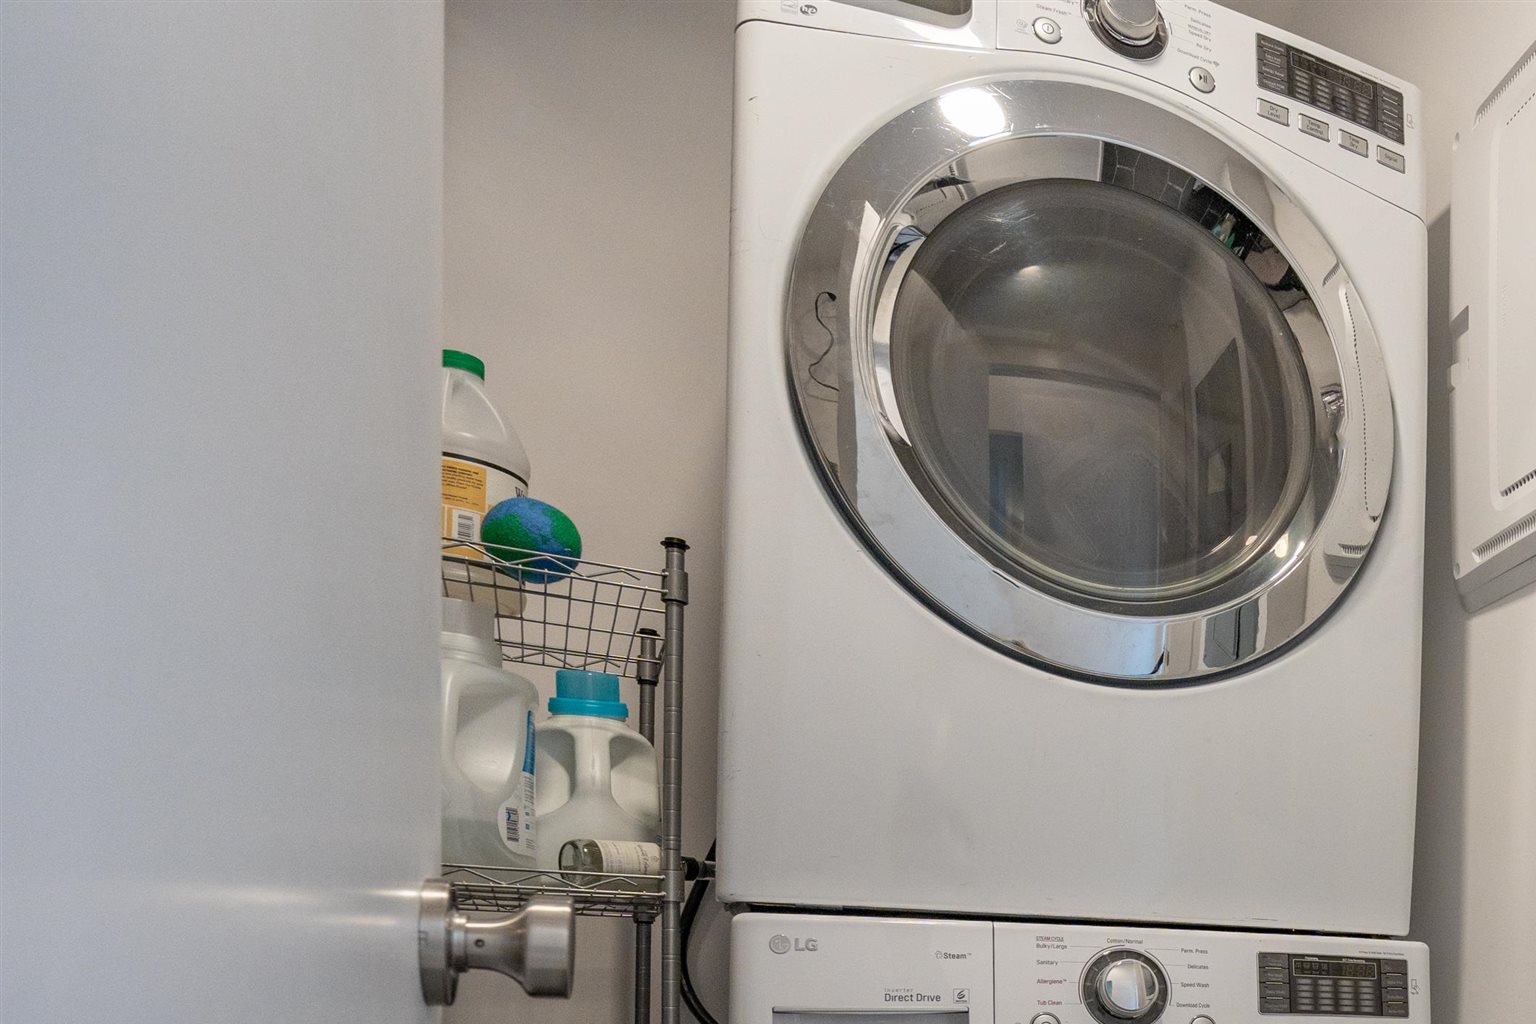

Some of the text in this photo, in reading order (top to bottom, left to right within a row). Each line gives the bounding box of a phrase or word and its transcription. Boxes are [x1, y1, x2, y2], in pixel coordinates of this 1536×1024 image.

[794, 937, 818, 952] LG
[884, 993, 941, 1002] Direct Drive
